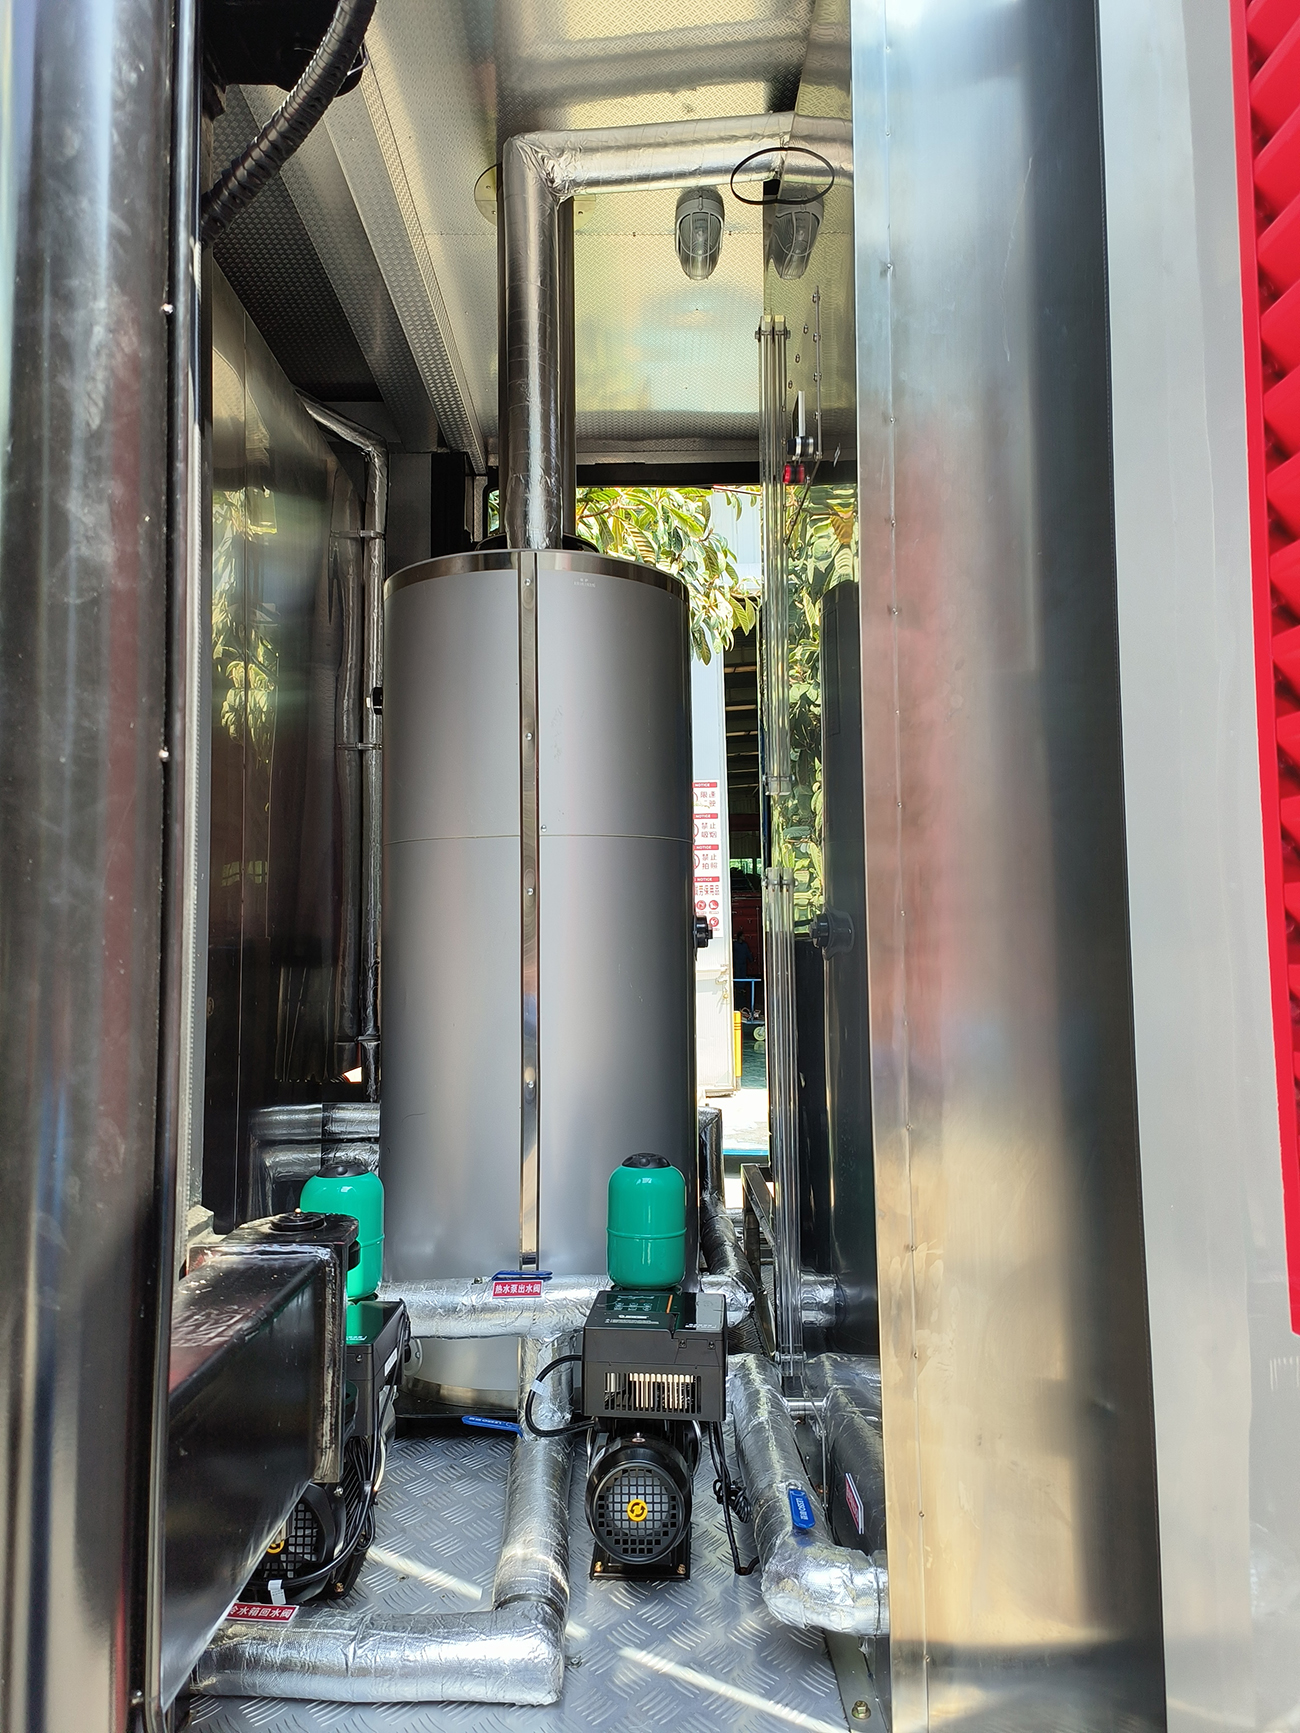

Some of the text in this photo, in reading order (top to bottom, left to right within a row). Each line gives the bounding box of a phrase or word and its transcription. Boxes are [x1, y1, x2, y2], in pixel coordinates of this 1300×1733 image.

[700, 791, 716, 799] 限速
[701, 822, 716, 830] 禁止
[702, 853, 717, 861] 禁止
[702, 862, 718, 870] 拍照
[495, 1284, 541, 1294] 热水泵出水阀
